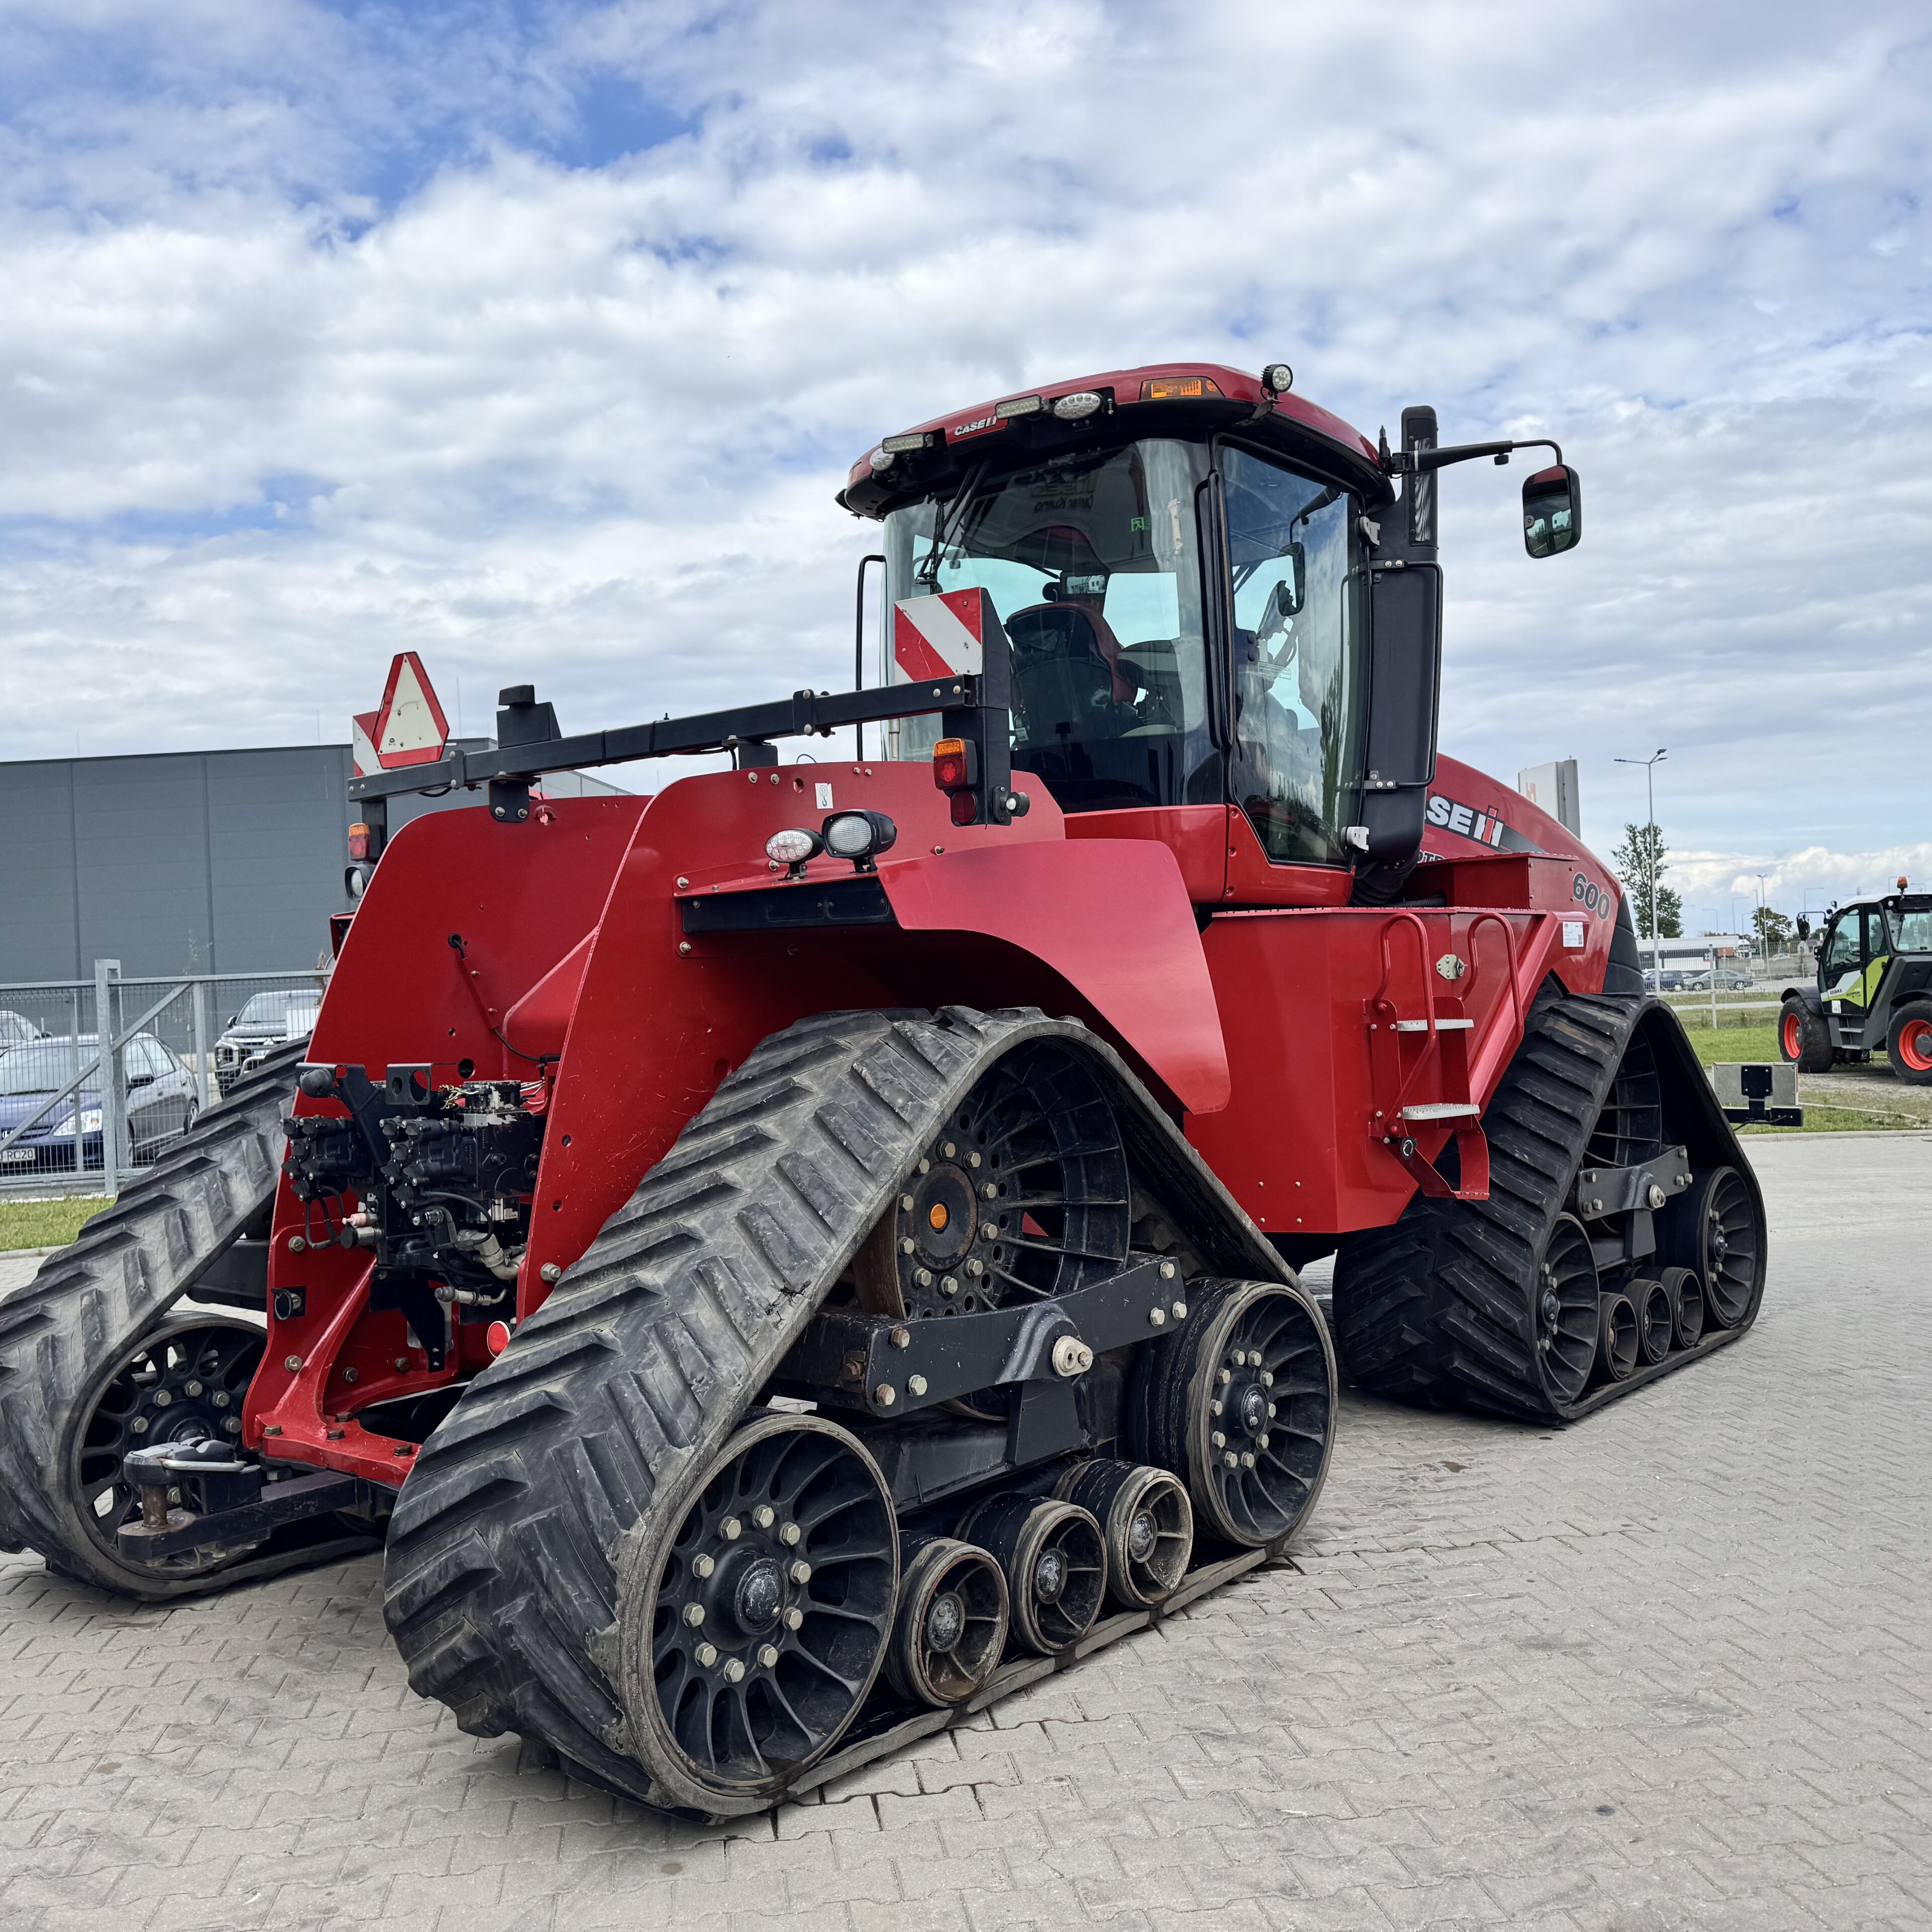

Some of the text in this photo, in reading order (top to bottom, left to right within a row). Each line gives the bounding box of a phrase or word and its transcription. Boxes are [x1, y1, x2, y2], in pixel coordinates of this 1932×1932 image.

[954, 419, 986, 436] CASE
[1425, 796, 1473, 835] SE
[1573, 871, 1611, 921] 600
